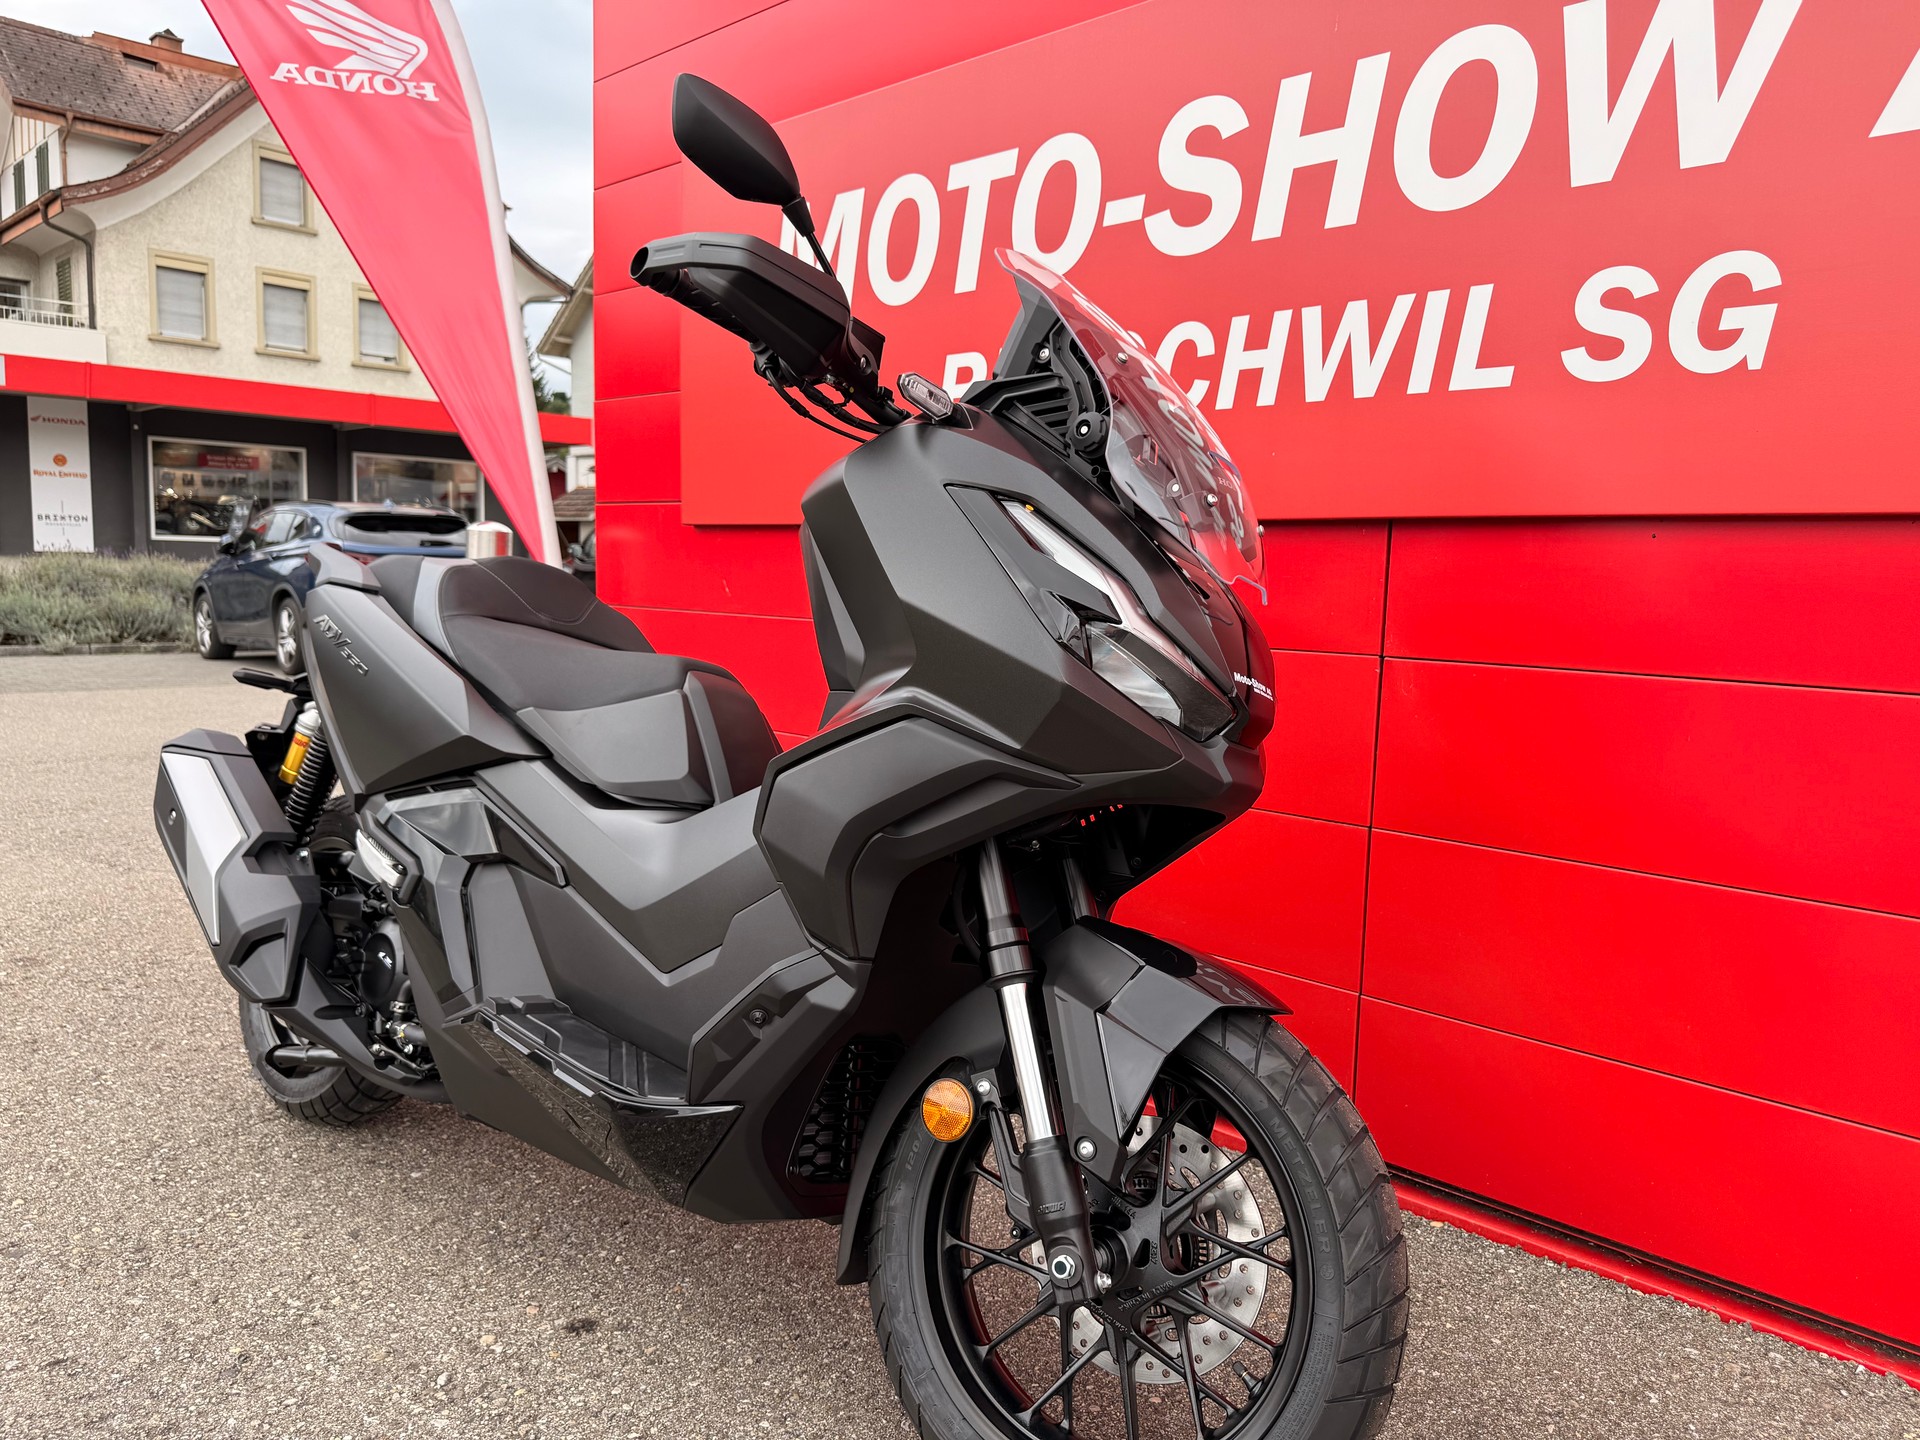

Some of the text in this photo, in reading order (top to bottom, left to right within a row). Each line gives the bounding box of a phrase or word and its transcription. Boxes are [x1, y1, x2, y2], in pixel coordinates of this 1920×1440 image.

[778, 0, 1802, 307] MOTO-SHOW
[1561, 251, 1782, 382] SG
[42, 416, 86, 426] HONDA
[33, 469, 88, 479] ROYAL ENFIELD
[37, 514, 88, 522] BRIXTON
[313, 614, 352, 648] ADV
[1269, 1116, 1332, 1254] METZELER
